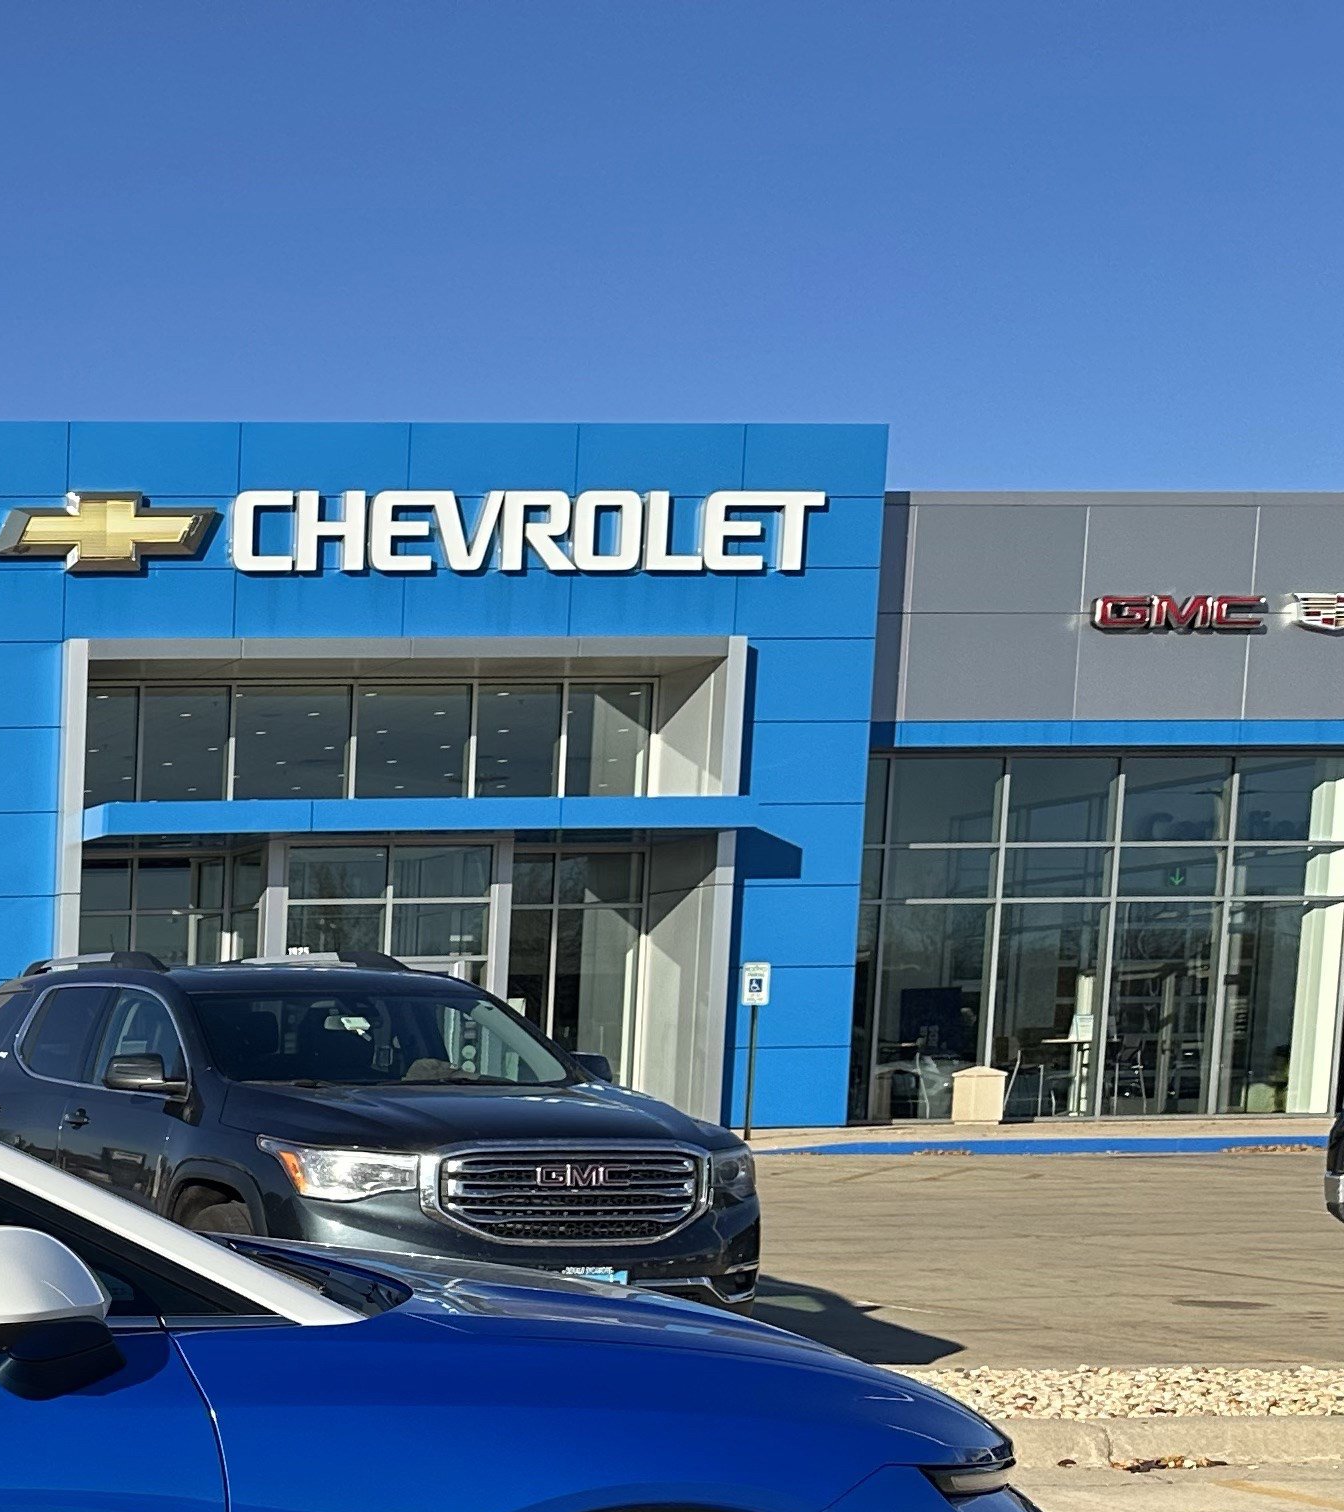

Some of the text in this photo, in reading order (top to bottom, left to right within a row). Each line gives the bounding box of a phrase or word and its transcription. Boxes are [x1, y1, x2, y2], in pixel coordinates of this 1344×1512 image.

[231, 489, 826, 572] CHEVROLET
[1093, 594, 1266, 630] GMC
[535, 1163, 631, 1187] GMC
